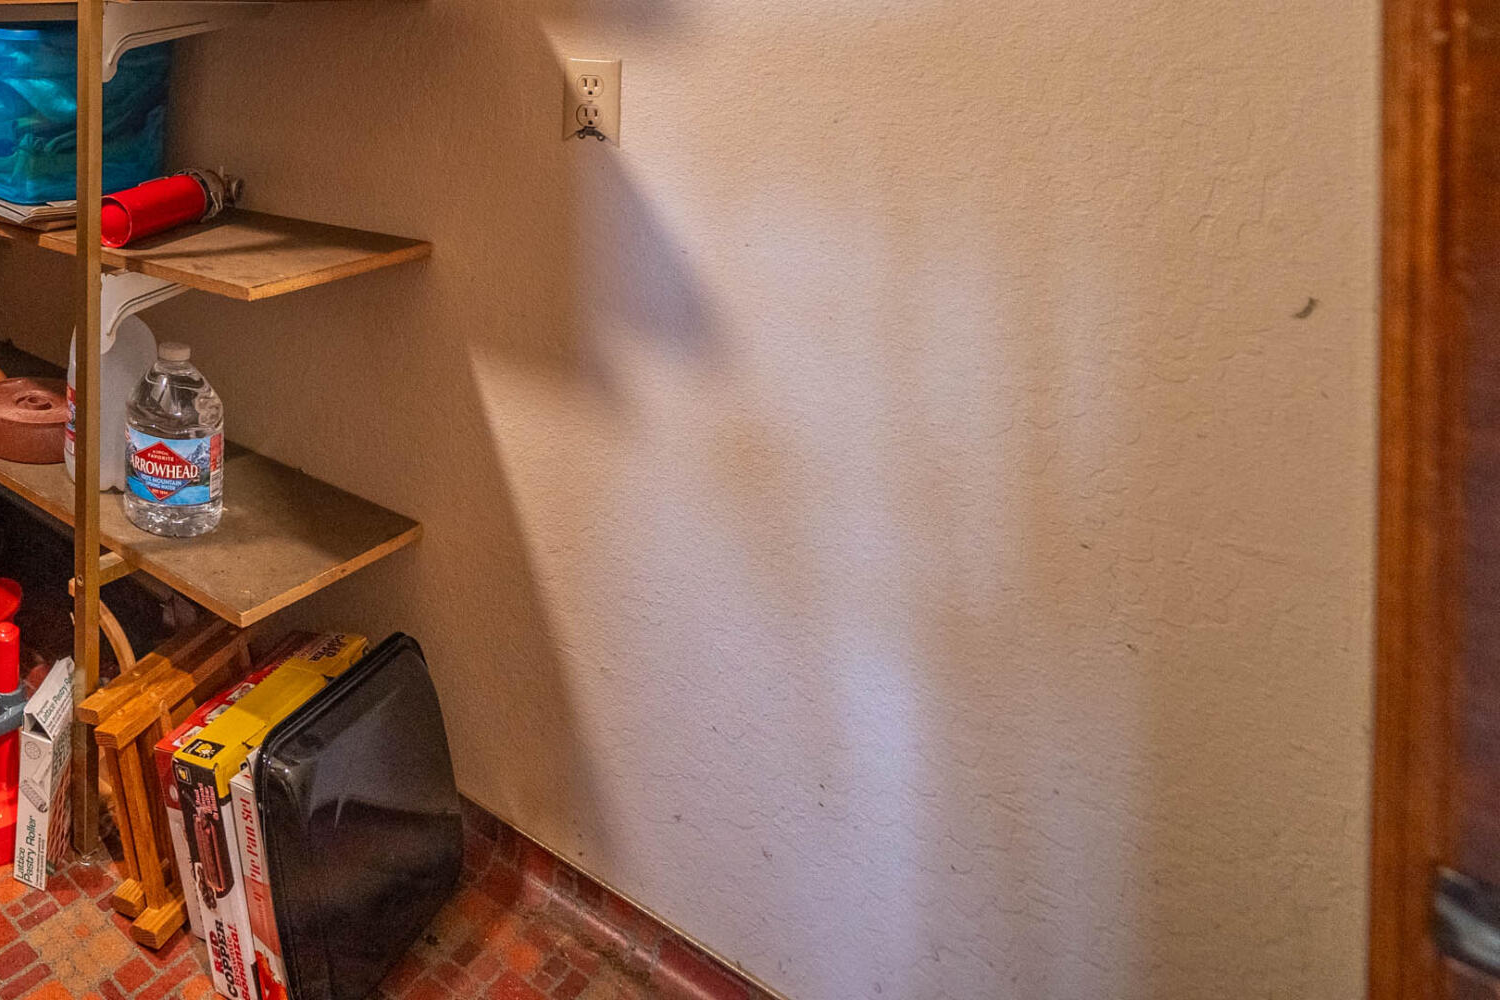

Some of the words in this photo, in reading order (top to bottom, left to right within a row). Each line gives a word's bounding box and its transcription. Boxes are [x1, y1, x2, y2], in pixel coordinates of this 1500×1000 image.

[131, 454, 198, 479] ARROWHEAD
[26, 815, 37, 847] Roller
[245, 826, 258, 858] Pan
[16, 847, 26, 880] Lattice
[24, 848, 37, 884] Pastry
[209, 930, 224, 975] RED
[215, 919, 238, 998] COPPER
